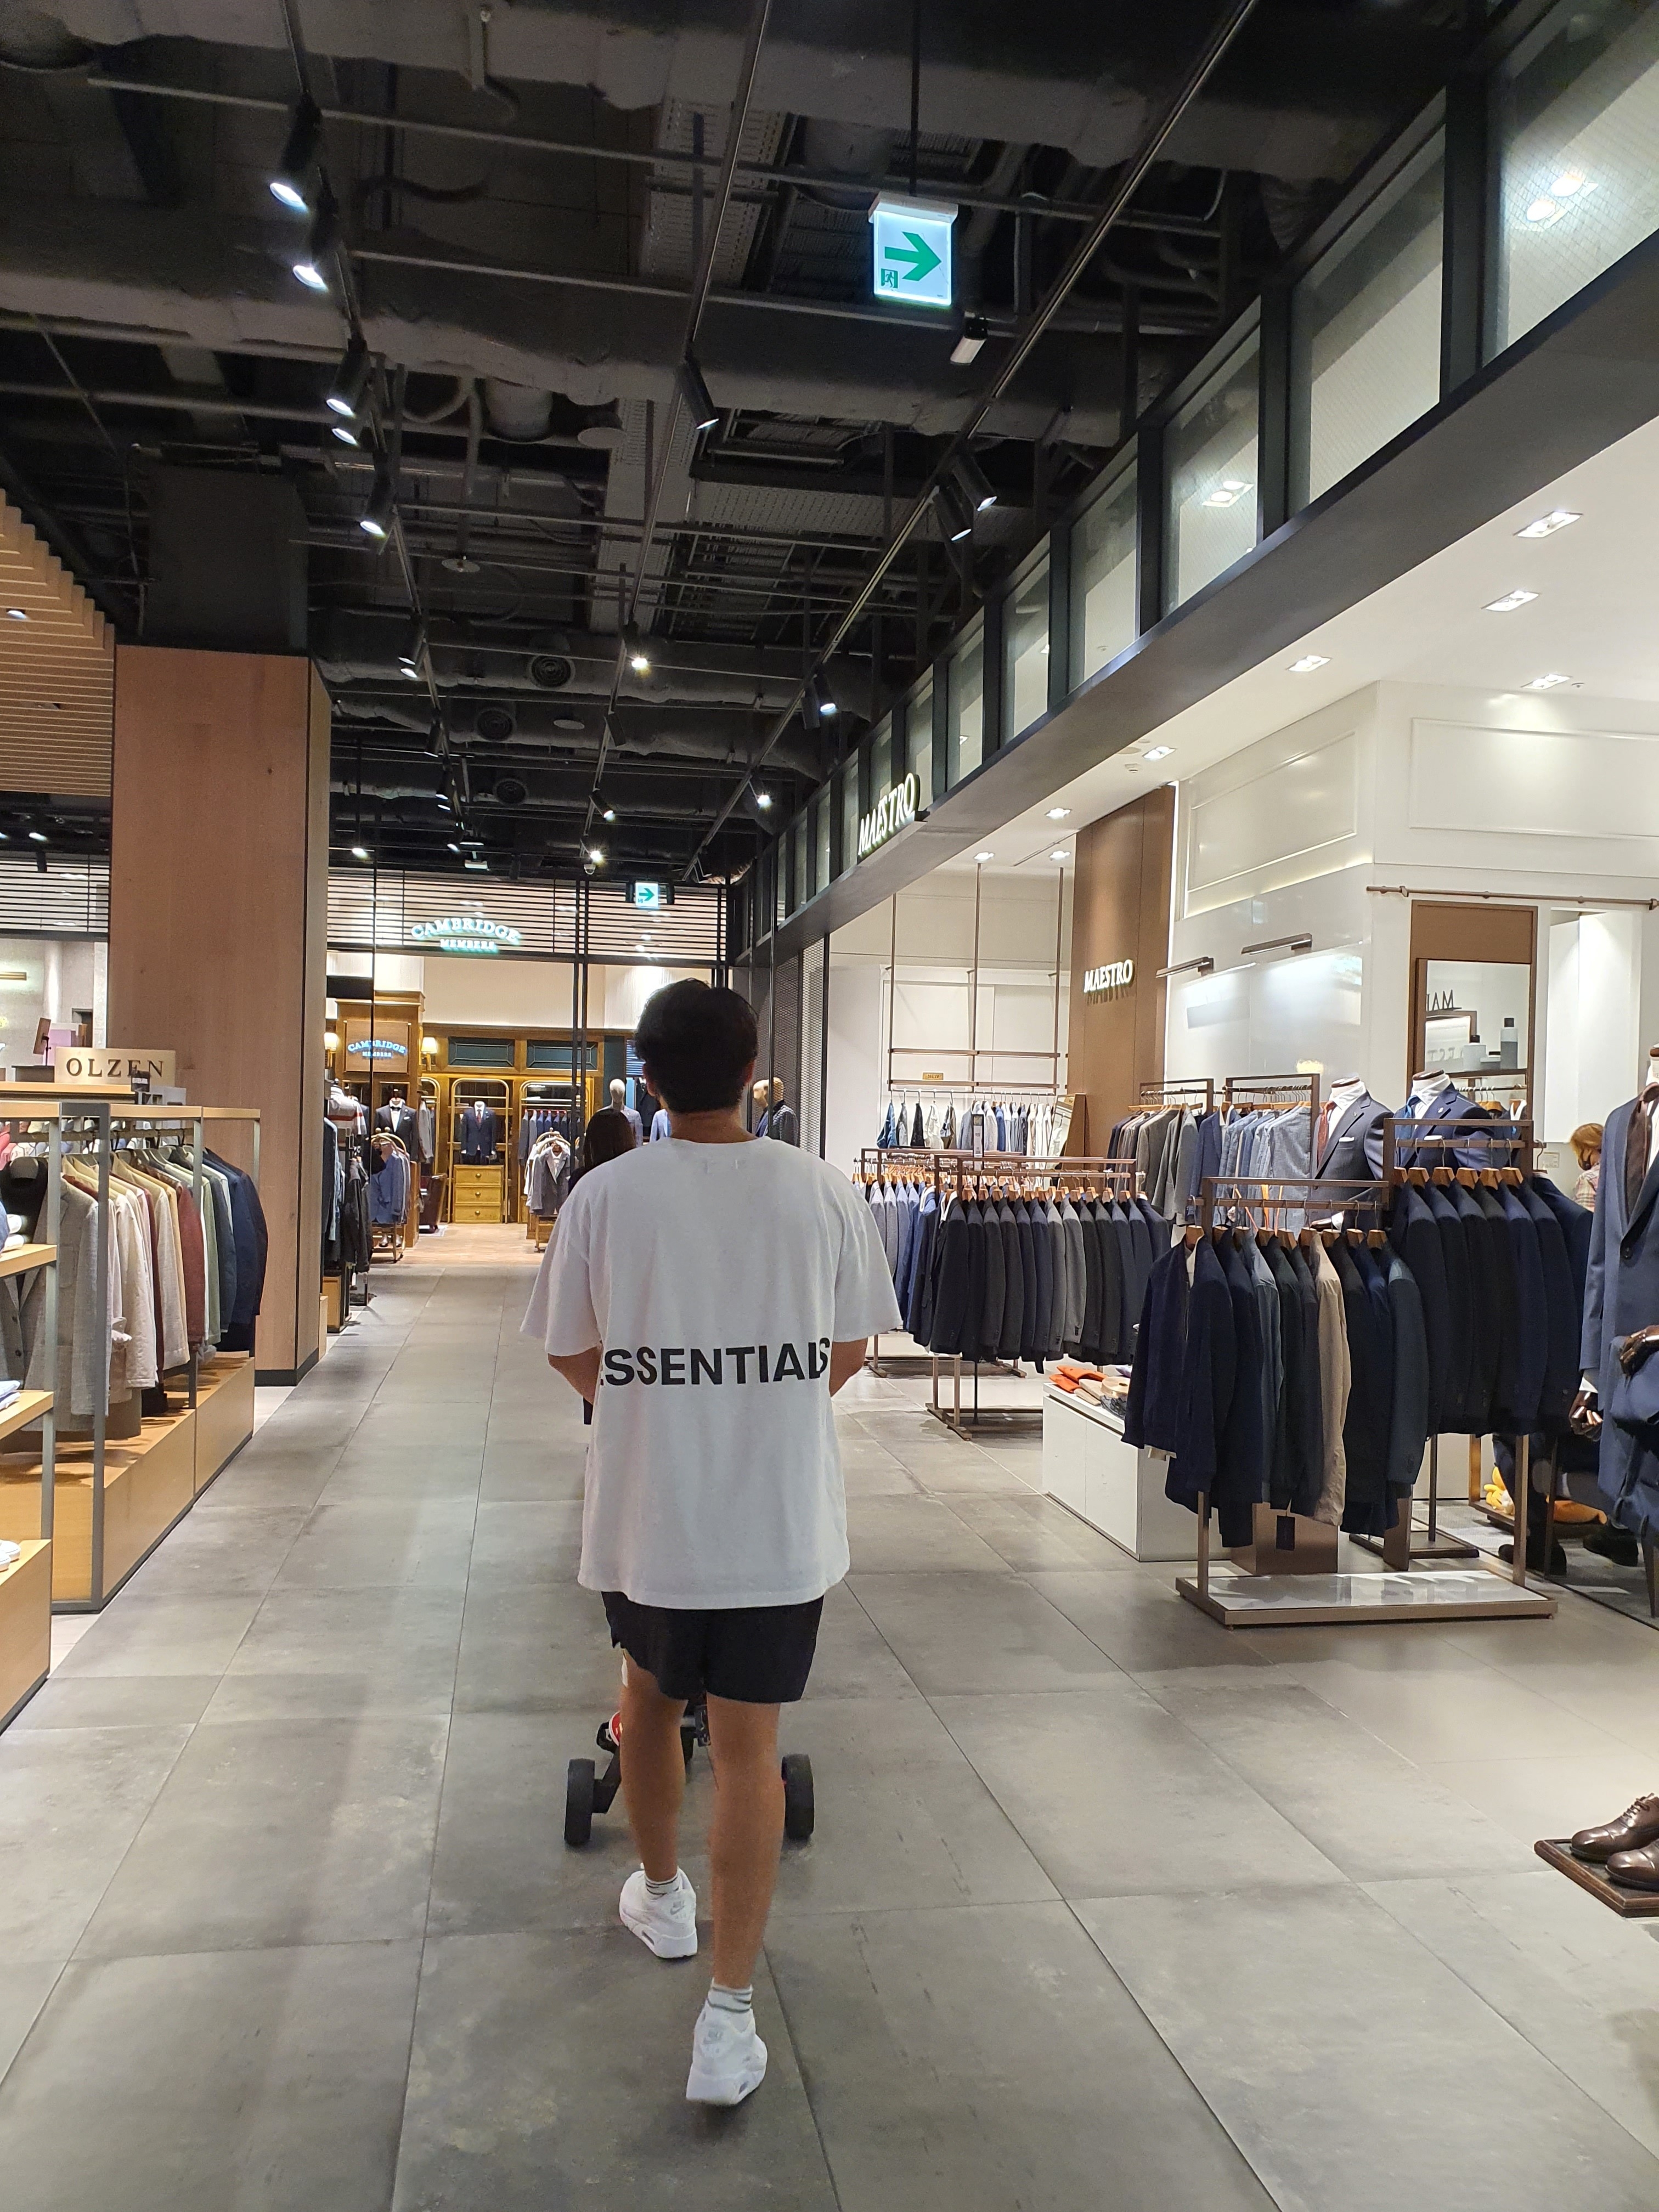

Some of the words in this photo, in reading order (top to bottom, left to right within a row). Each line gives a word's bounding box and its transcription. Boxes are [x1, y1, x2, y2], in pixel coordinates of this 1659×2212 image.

[858, 772, 915, 855] MAESTRO
[411, 918, 521, 945] CAMBRIDGE
[1084, 959, 1133, 993] MAESTRO
[66, 1058, 163, 1077] OLZEN
[601, 1338, 830, 1386] SSENTIALS
